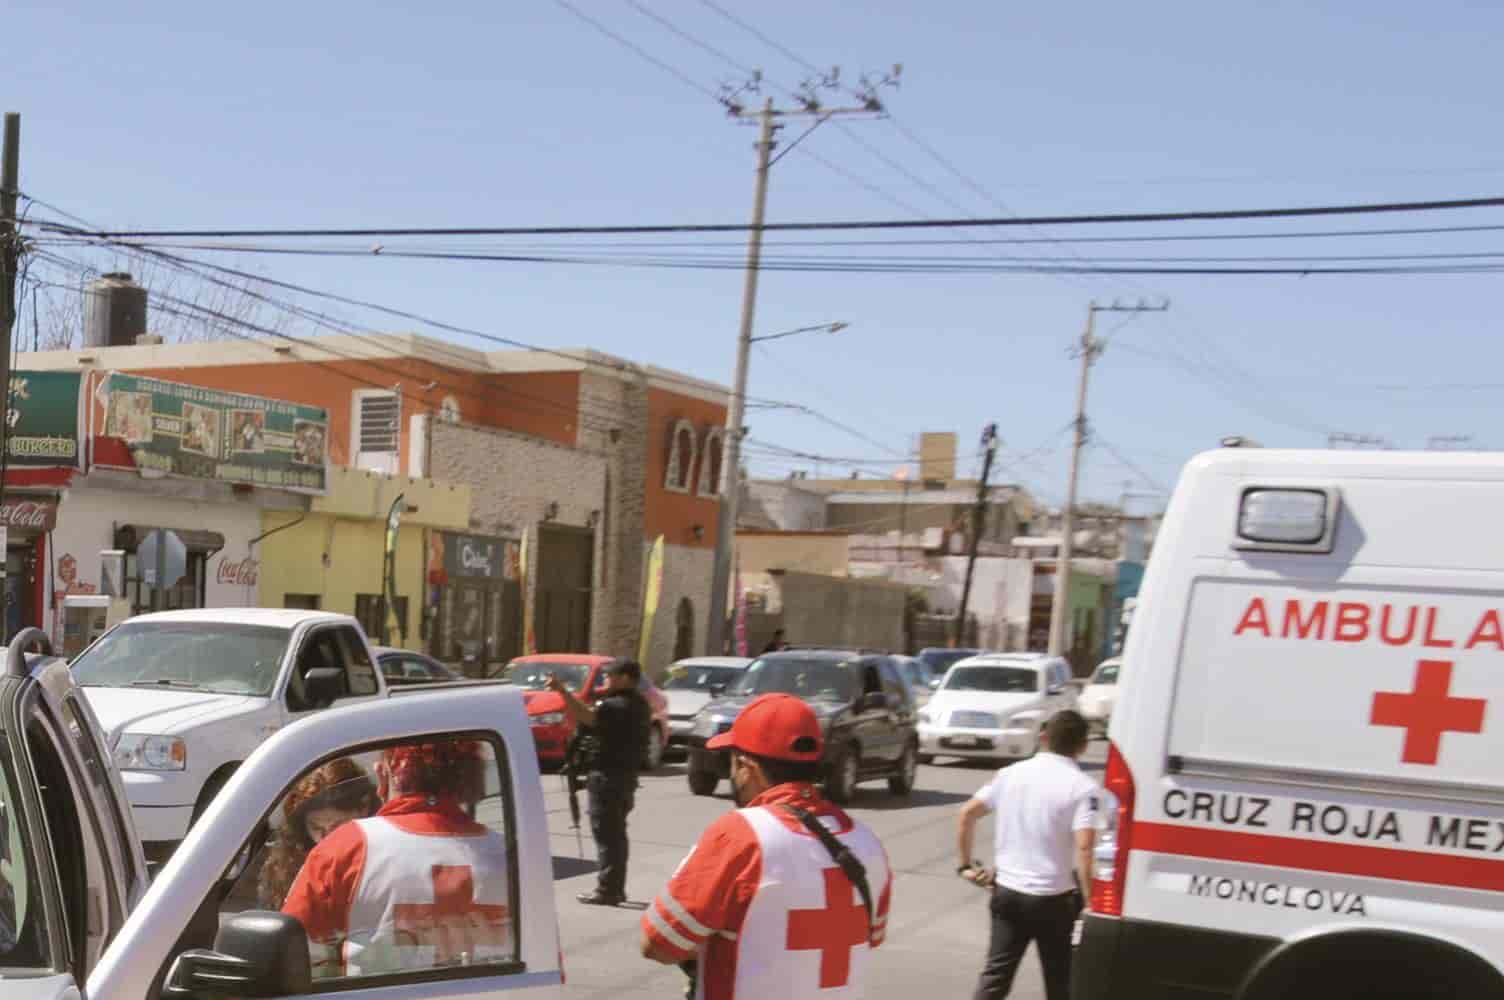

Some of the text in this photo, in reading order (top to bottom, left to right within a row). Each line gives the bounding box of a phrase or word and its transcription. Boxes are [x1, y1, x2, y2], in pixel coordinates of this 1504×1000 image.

[1233, 597, 1504, 651] AMBULA
[1163, 789, 1271, 828] CRUZ
[1291, 803, 1401, 842] ROJA
[1187, 874, 1367, 917] MONCLOVA
